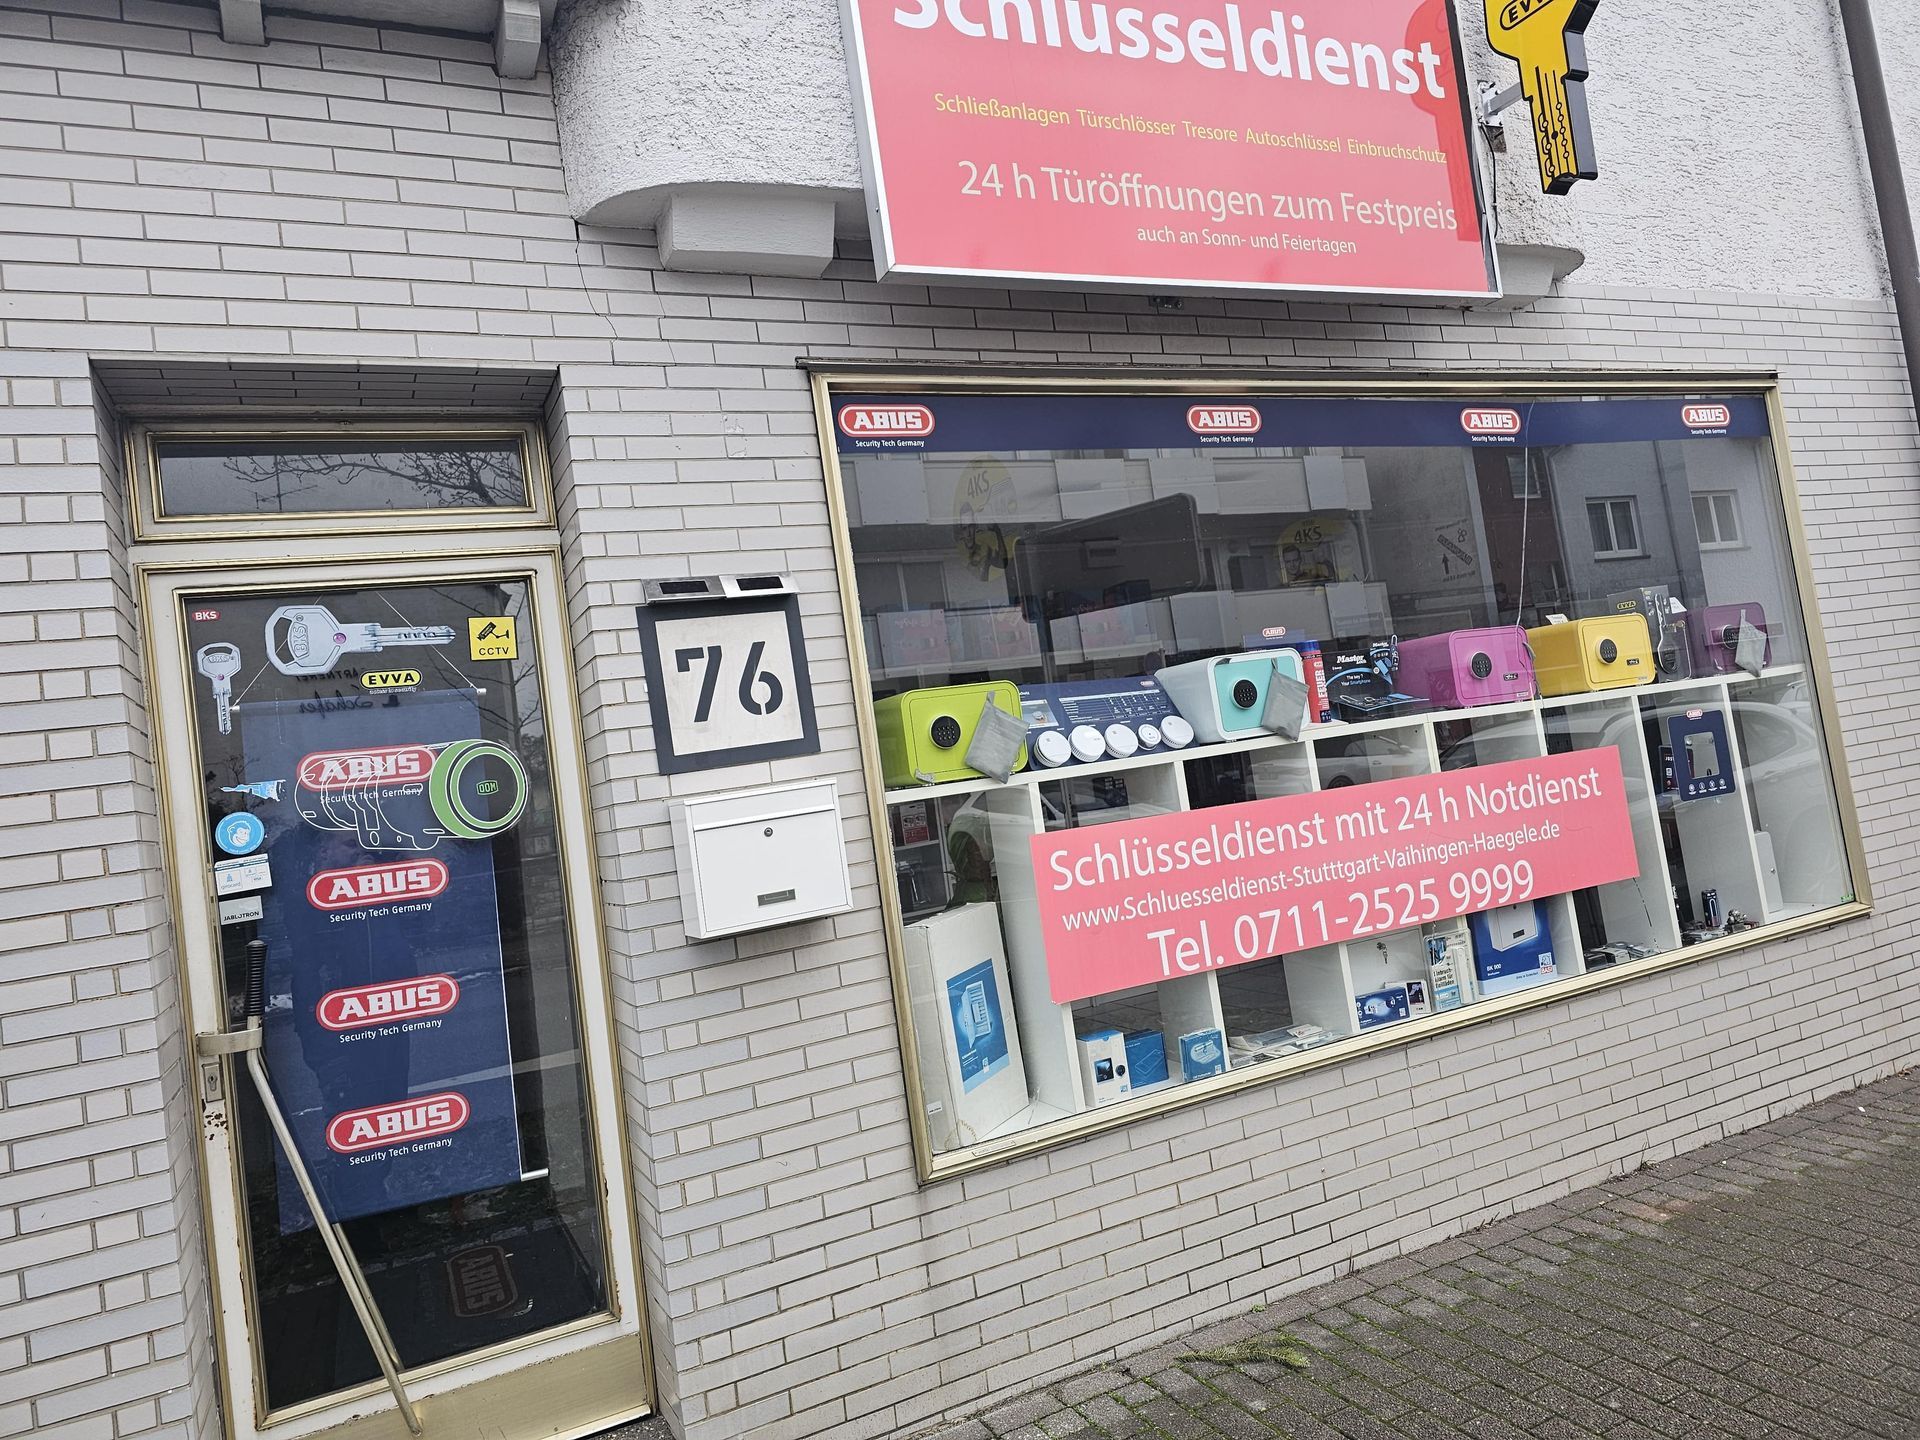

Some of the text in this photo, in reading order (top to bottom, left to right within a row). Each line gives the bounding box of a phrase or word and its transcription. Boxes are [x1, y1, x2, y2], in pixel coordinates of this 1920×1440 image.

[934, 92, 1448, 163] Schließanlagen Türschlösser Tresore Autoschlüssel Einbruchschutz
[958, 160, 1458, 234] 24 h Türöffnungen zum Festpreis
[1137, 225, 1357, 256] auch an Sonn- und Feiertagen
[853, 411, 923, 430] ABUS
[1198, 411, 1252, 428] ABUS
[1469, 413, 1513, 429] ABUS
[1689, 408, 1725, 422] ABUS
[855, 440, 881, 448] Security
[897, 440, 925, 448] Germany
[967, 469, 990, 499] 4KS
[1294, 525, 1322, 543] 4KS
[195, 611, 218, 621] BKS
[293, 626, 307, 652] BKS
[478, 646, 510, 656] CCTV
[1336, 655, 1365, 664] Master
[368, 672, 415, 686] EVVA
[674, 640, 784, 723] 76
[318, 753, 420, 783] ABUS
[358, 791, 378, 801] Tech
[382, 786, 423, 799] Germany
[478, 782, 498, 793] DOM
[1050, 767, 1602, 891] Schlüsseldienst mit 24 h Notdienst
[328, 867, 431, 900] ABUS
[1062, 819, 1561, 931] www.Schluesseldienst-Stutttgart-Vaihingen-Haegele.de
[223, 911, 260, 921] JABLOTRON
[329, 902, 433, 923] Security Tech Germany
[1146, 859, 1534, 976] Tel. 0711-2525 9999
[338, 984, 441, 1020] ABUS
[339, 1019, 443, 1043] Security Tech Germany
[348, 1101, 451, 1143] ABUS
[349, 1138, 453, 1166] Security Tech Germany
